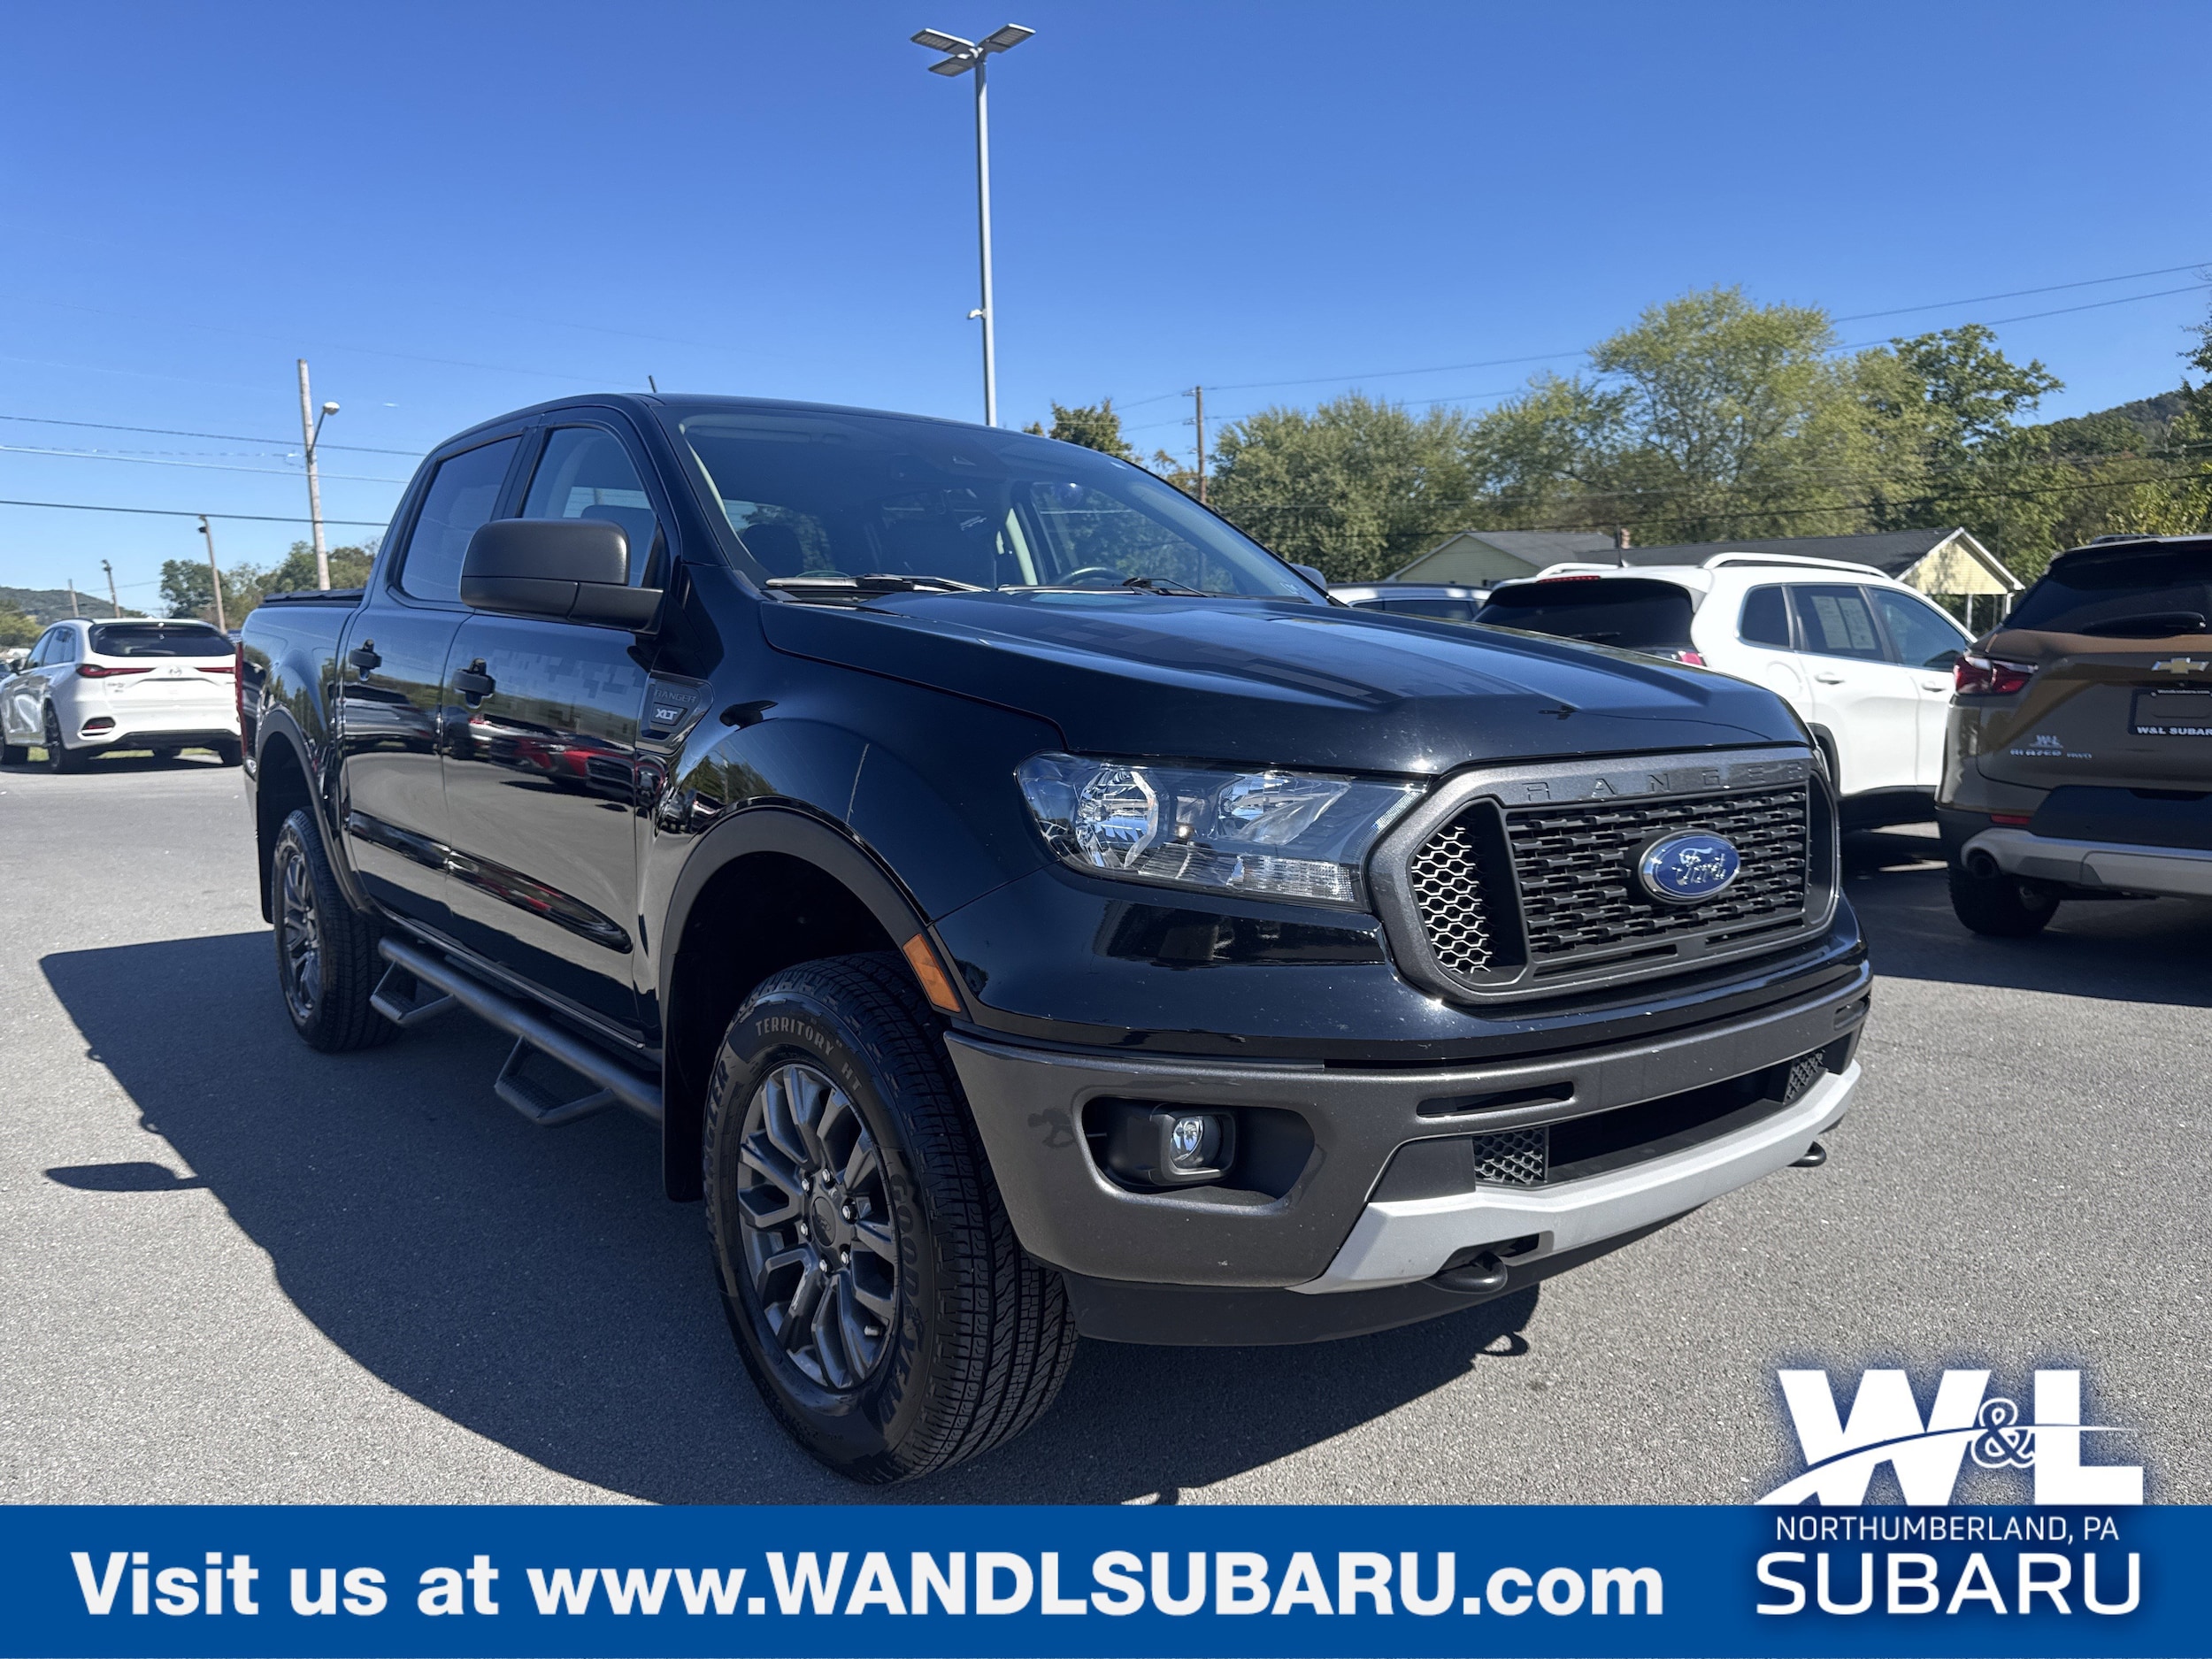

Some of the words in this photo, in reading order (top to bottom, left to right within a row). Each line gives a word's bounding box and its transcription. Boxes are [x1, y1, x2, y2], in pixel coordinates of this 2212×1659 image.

[655, 689, 697, 703] RANGER
[655, 709, 678, 720] XLT
[2136, 726, 2167, 735] W&L
[1522, 762, 1803, 802] RANGER
[1671, 847, 1726, 886] Ford
[755, 1017, 835, 1056] TERRITORY
[841, 1062, 863, 1091] HT
[879, 1173, 922, 1425] GOODYEAR
